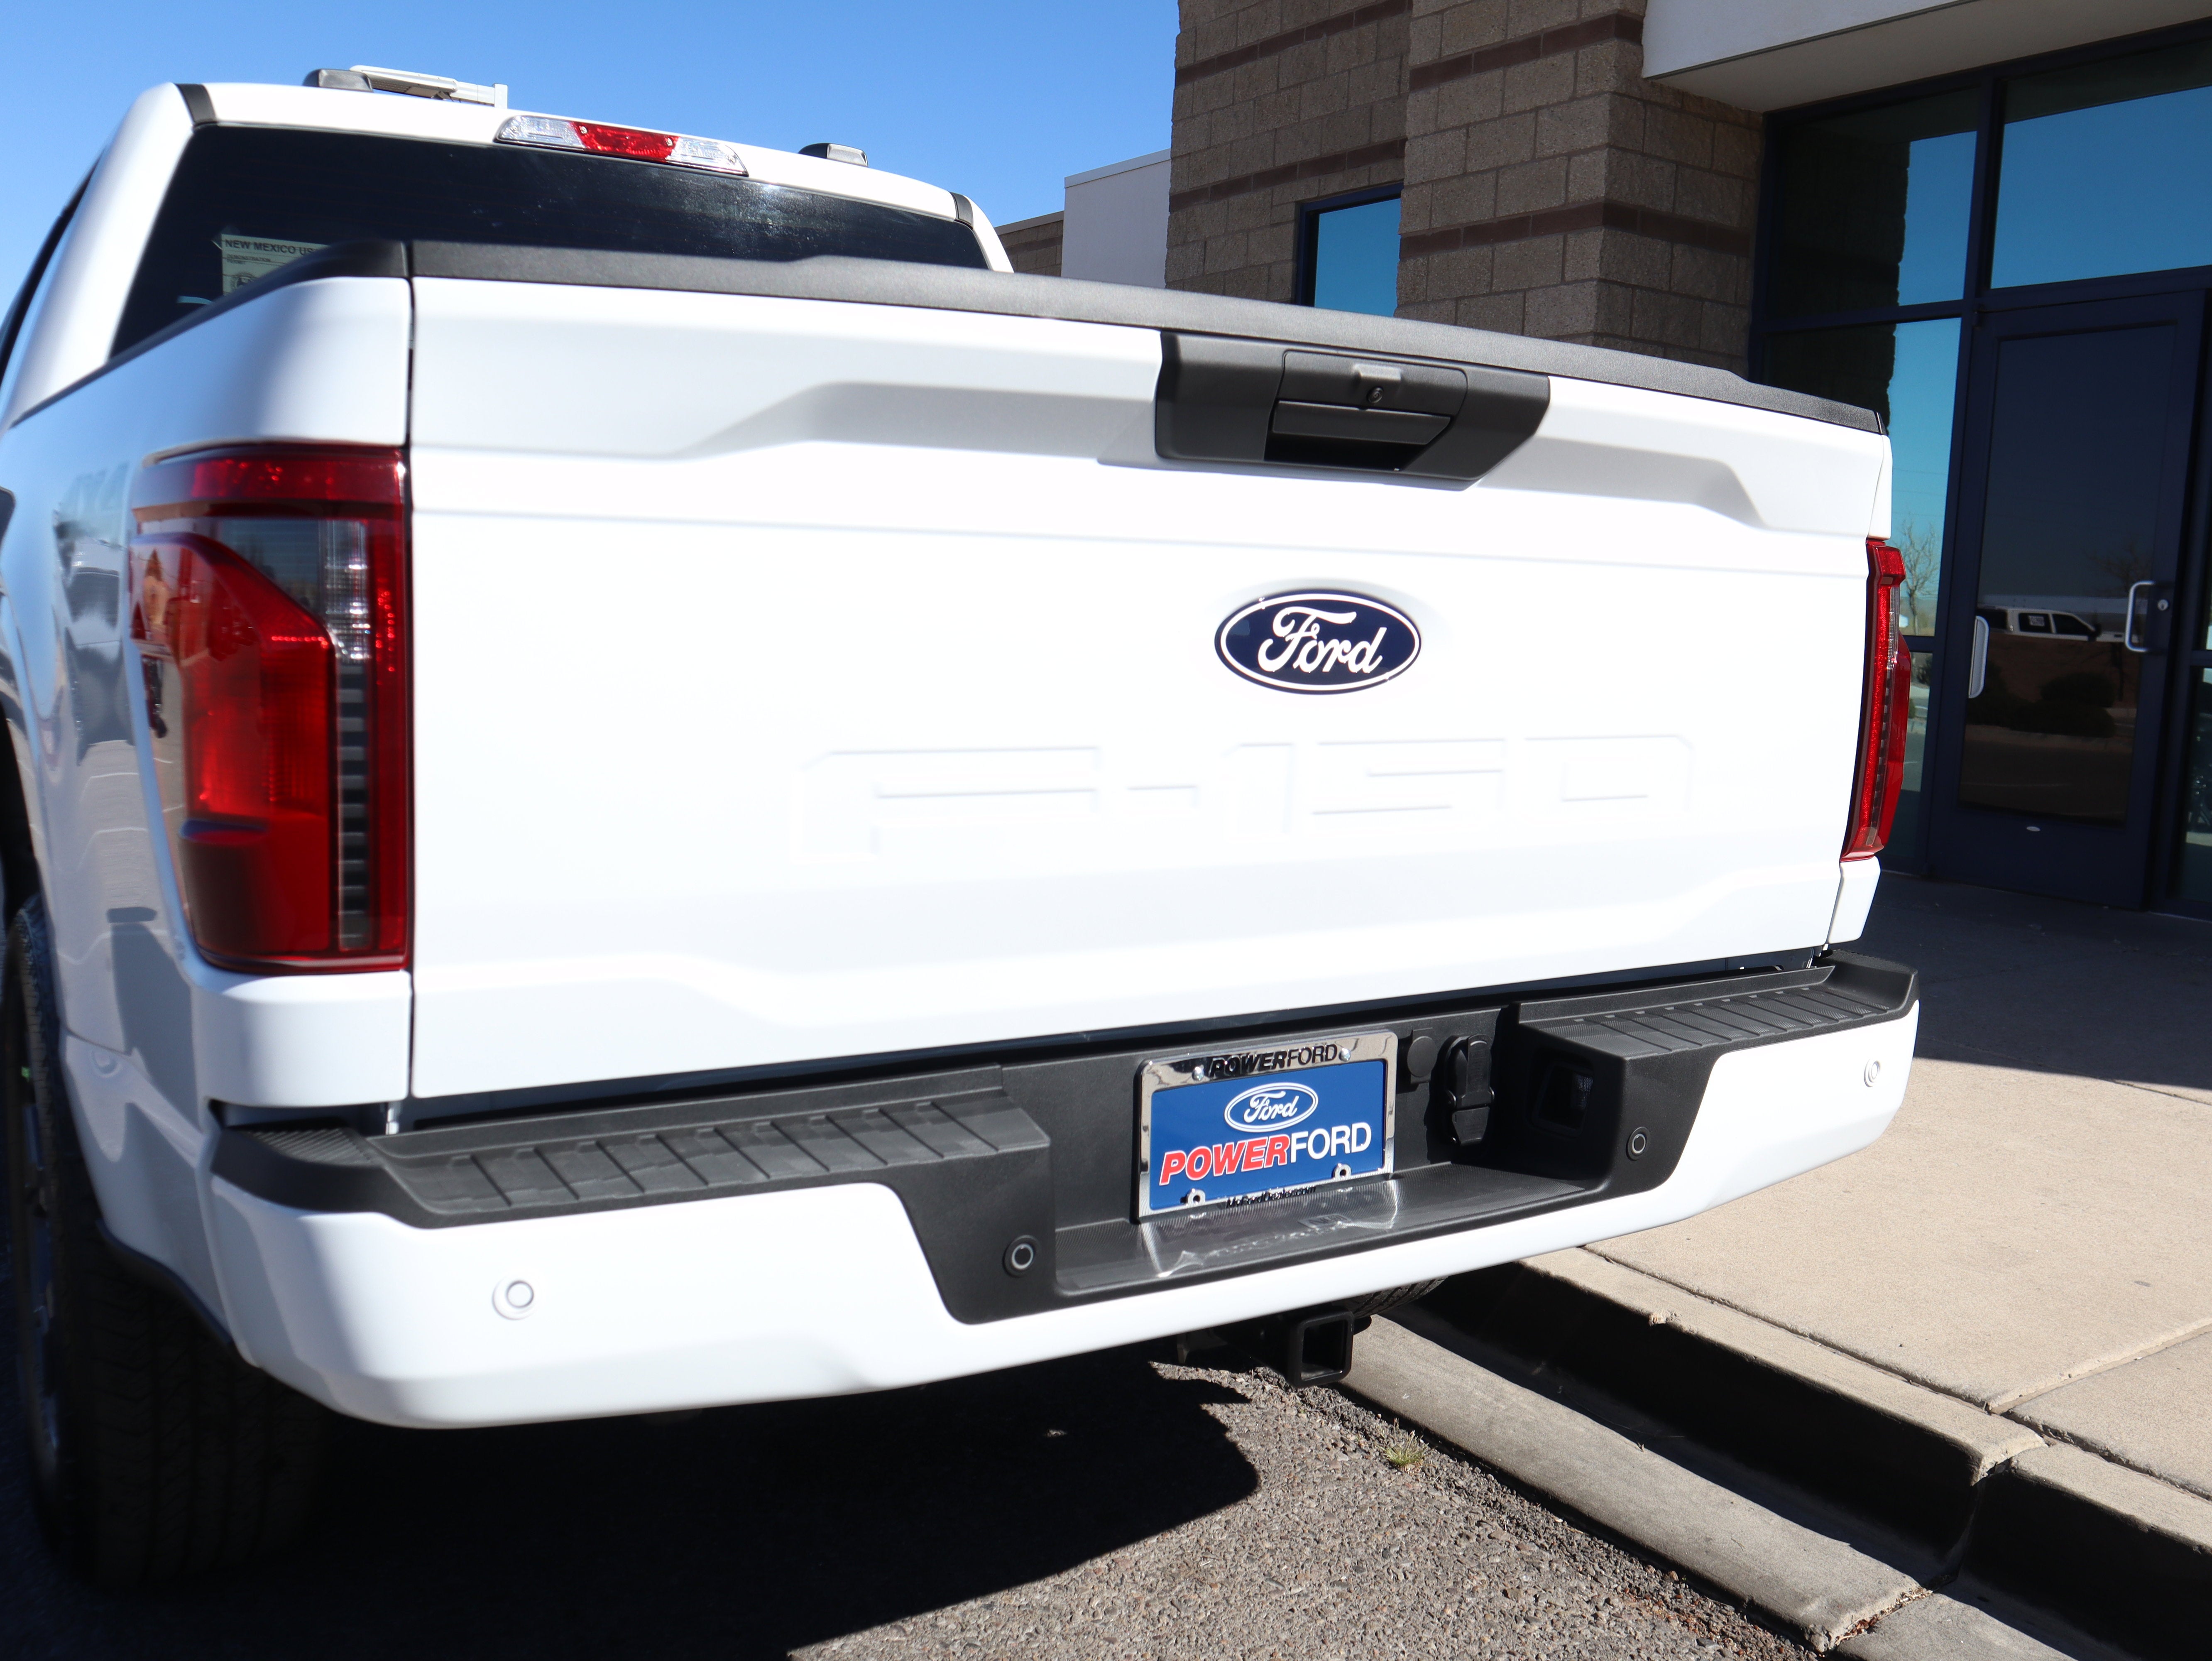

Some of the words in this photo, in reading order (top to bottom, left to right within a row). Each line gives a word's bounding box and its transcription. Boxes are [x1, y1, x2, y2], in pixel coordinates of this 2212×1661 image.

[225, 239, 250, 249] NEW
[254, 242, 296, 254] MEXICO
[1258, 606, 1387, 674] Ford
[790, 733, 1694, 863] F-150
[1209, 1044, 1337, 1078] POWERFORD
[1243, 1090, 1299, 1123] Ford
[1159, 1122, 1372, 1186] POWERFORD
